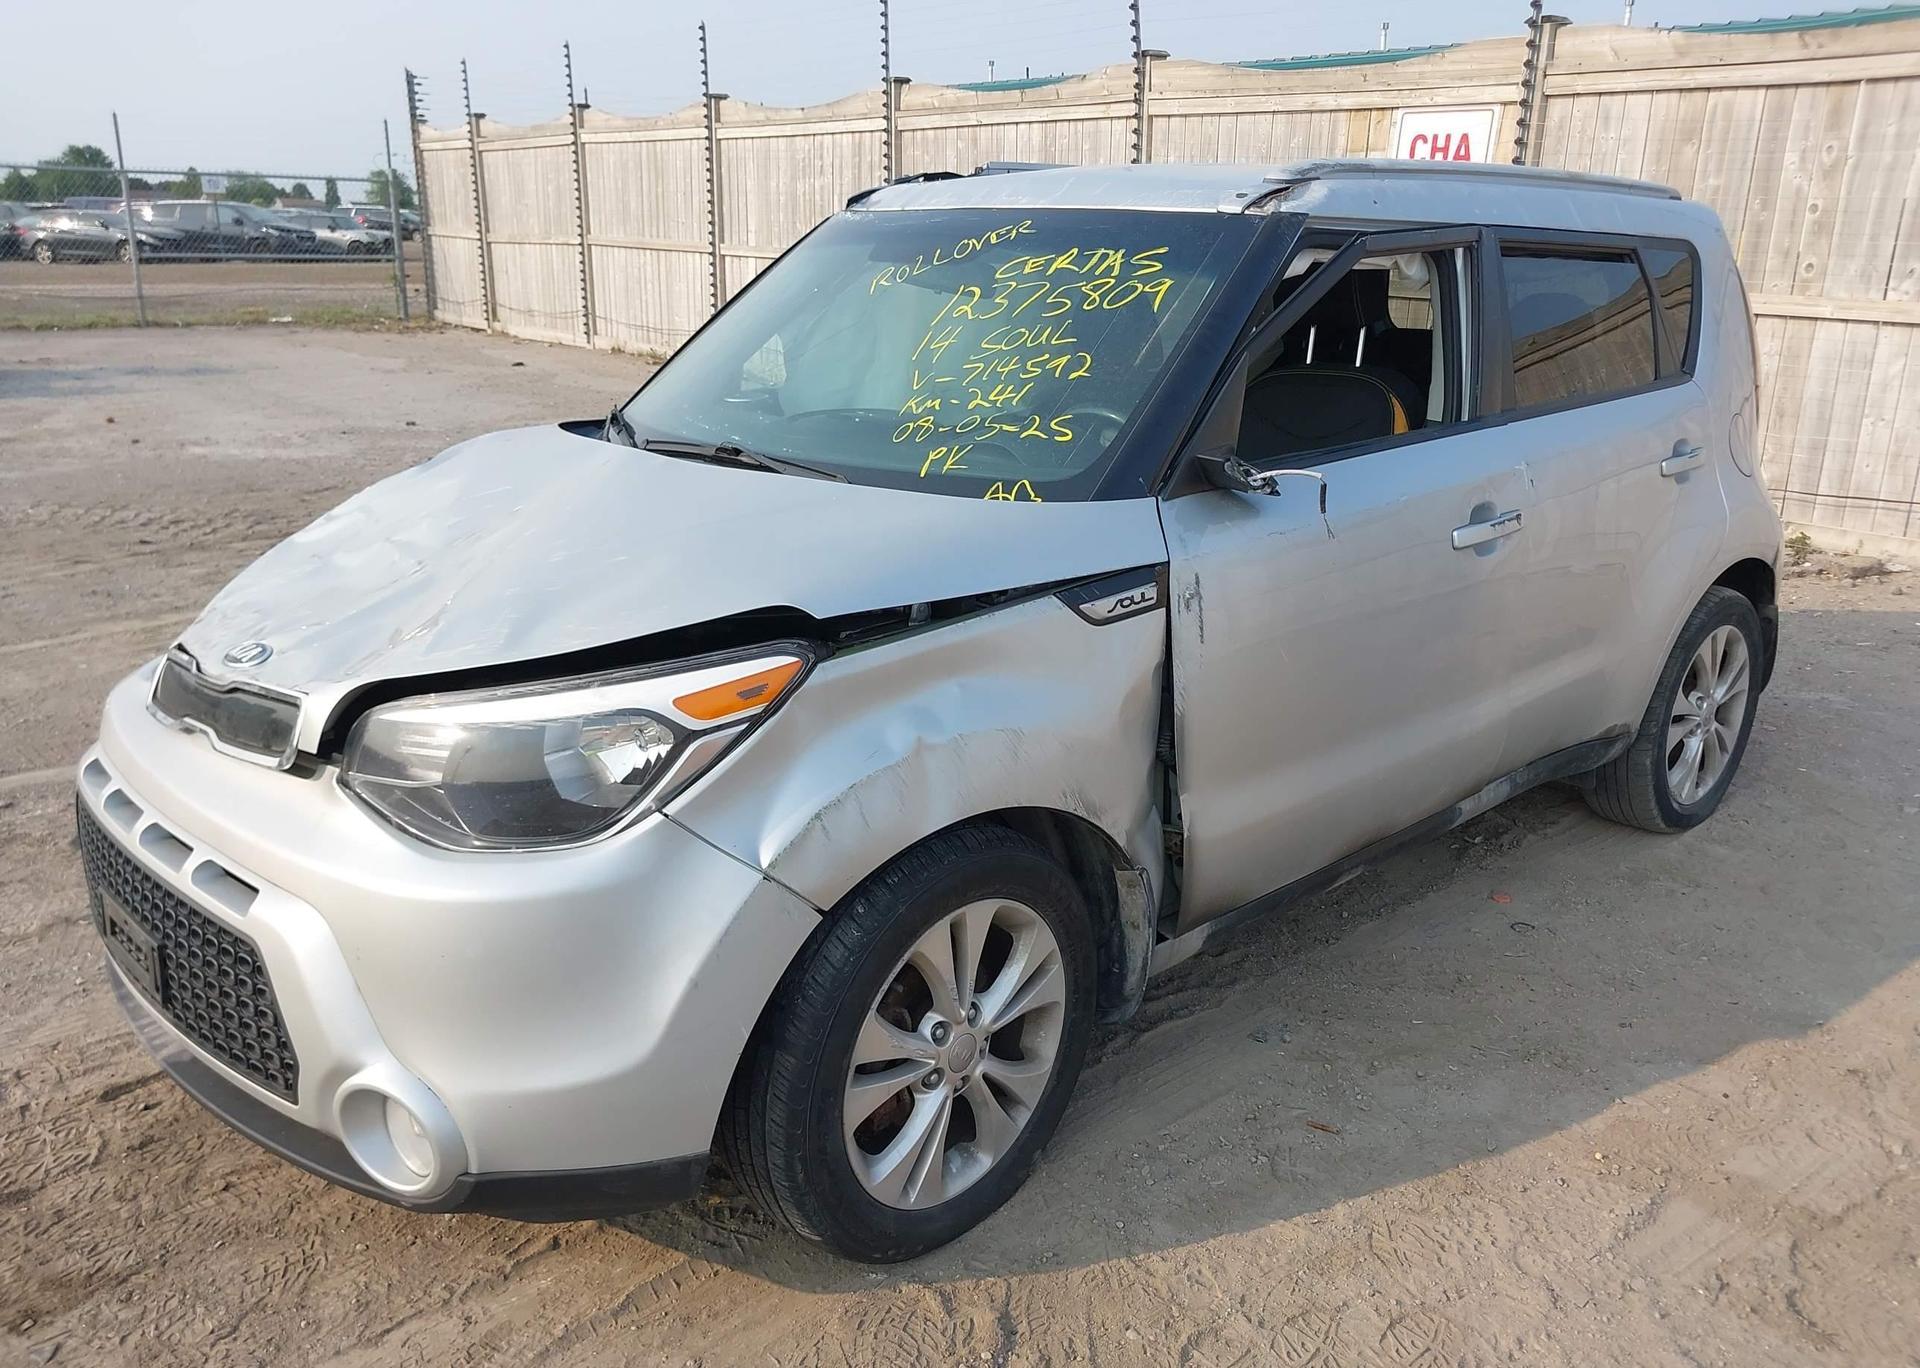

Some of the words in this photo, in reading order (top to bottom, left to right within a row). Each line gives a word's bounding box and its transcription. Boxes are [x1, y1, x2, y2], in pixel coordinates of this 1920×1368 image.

[1409, 132, 1471, 162] CHA
[869, 219, 1037, 296] ROLLOVER
[994, 246, 1170, 279] CERTAS
[930, 277, 1176, 327] 12375809
[911, 325, 963, 364] 14
[969, 319, 1078, 360] SOUL
[919, 444, 974, 478] PK
[1107, 591, 1155, 614] SOUL
